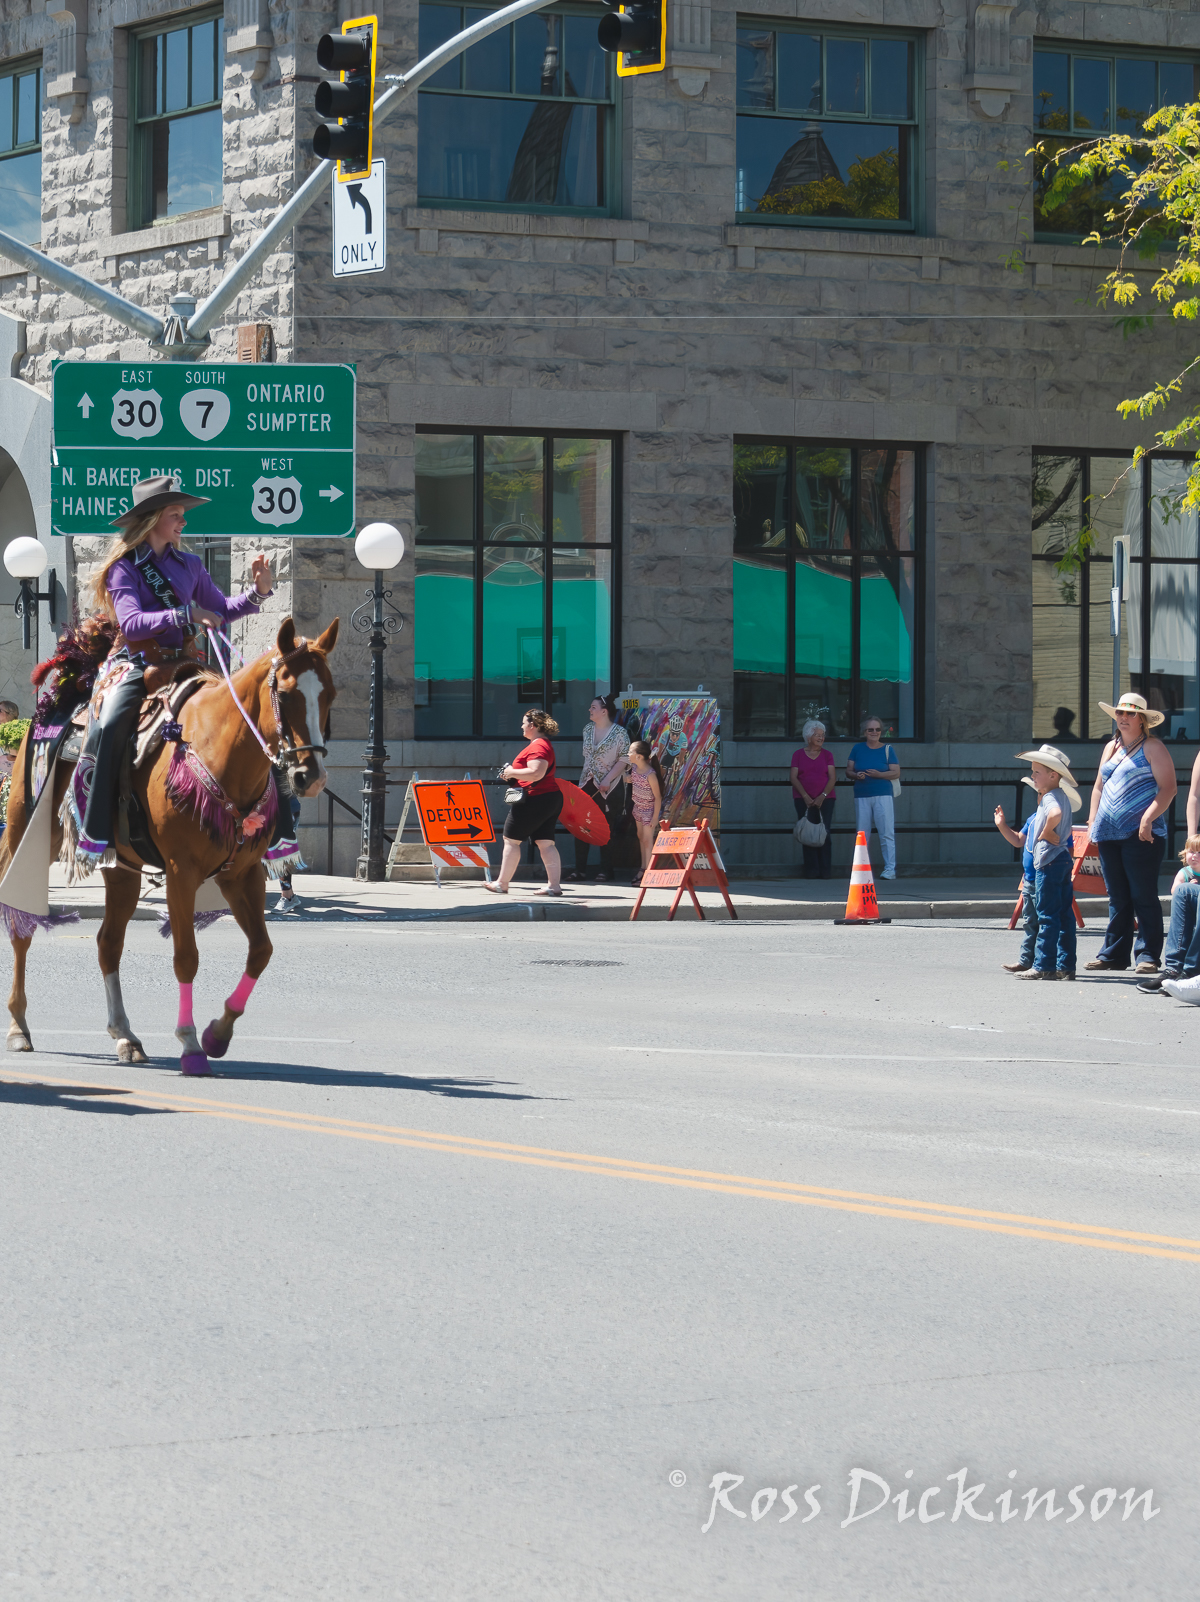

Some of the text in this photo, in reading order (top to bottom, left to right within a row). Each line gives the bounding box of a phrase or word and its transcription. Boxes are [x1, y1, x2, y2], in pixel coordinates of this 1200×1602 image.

[341, 240, 377, 265] ONLY
[121, 370, 153, 384] EAST
[185, 370, 225, 385] SOUTH
[246, 383, 325, 403] ONTARIO
[117, 399, 157, 428] 30
[195, 401, 214, 429] 7
[246, 412, 332, 432] SUMPTER
[261, 458, 294, 471] WEST
[62, 467, 77, 486] N.
[86, 467, 141, 487] BAKER
[195, 468, 235, 488] DIST.
[62, 497, 129, 516] HAINES
[257, 486, 297, 515] 30
[155, 589, 176, 610] Juni
[622, 699, 640, 709] 13015
[426, 807, 484, 823] DETOUR
[656, 836, 695, 847] BAKER CITY
[643, 872, 683, 886] CAUTION
